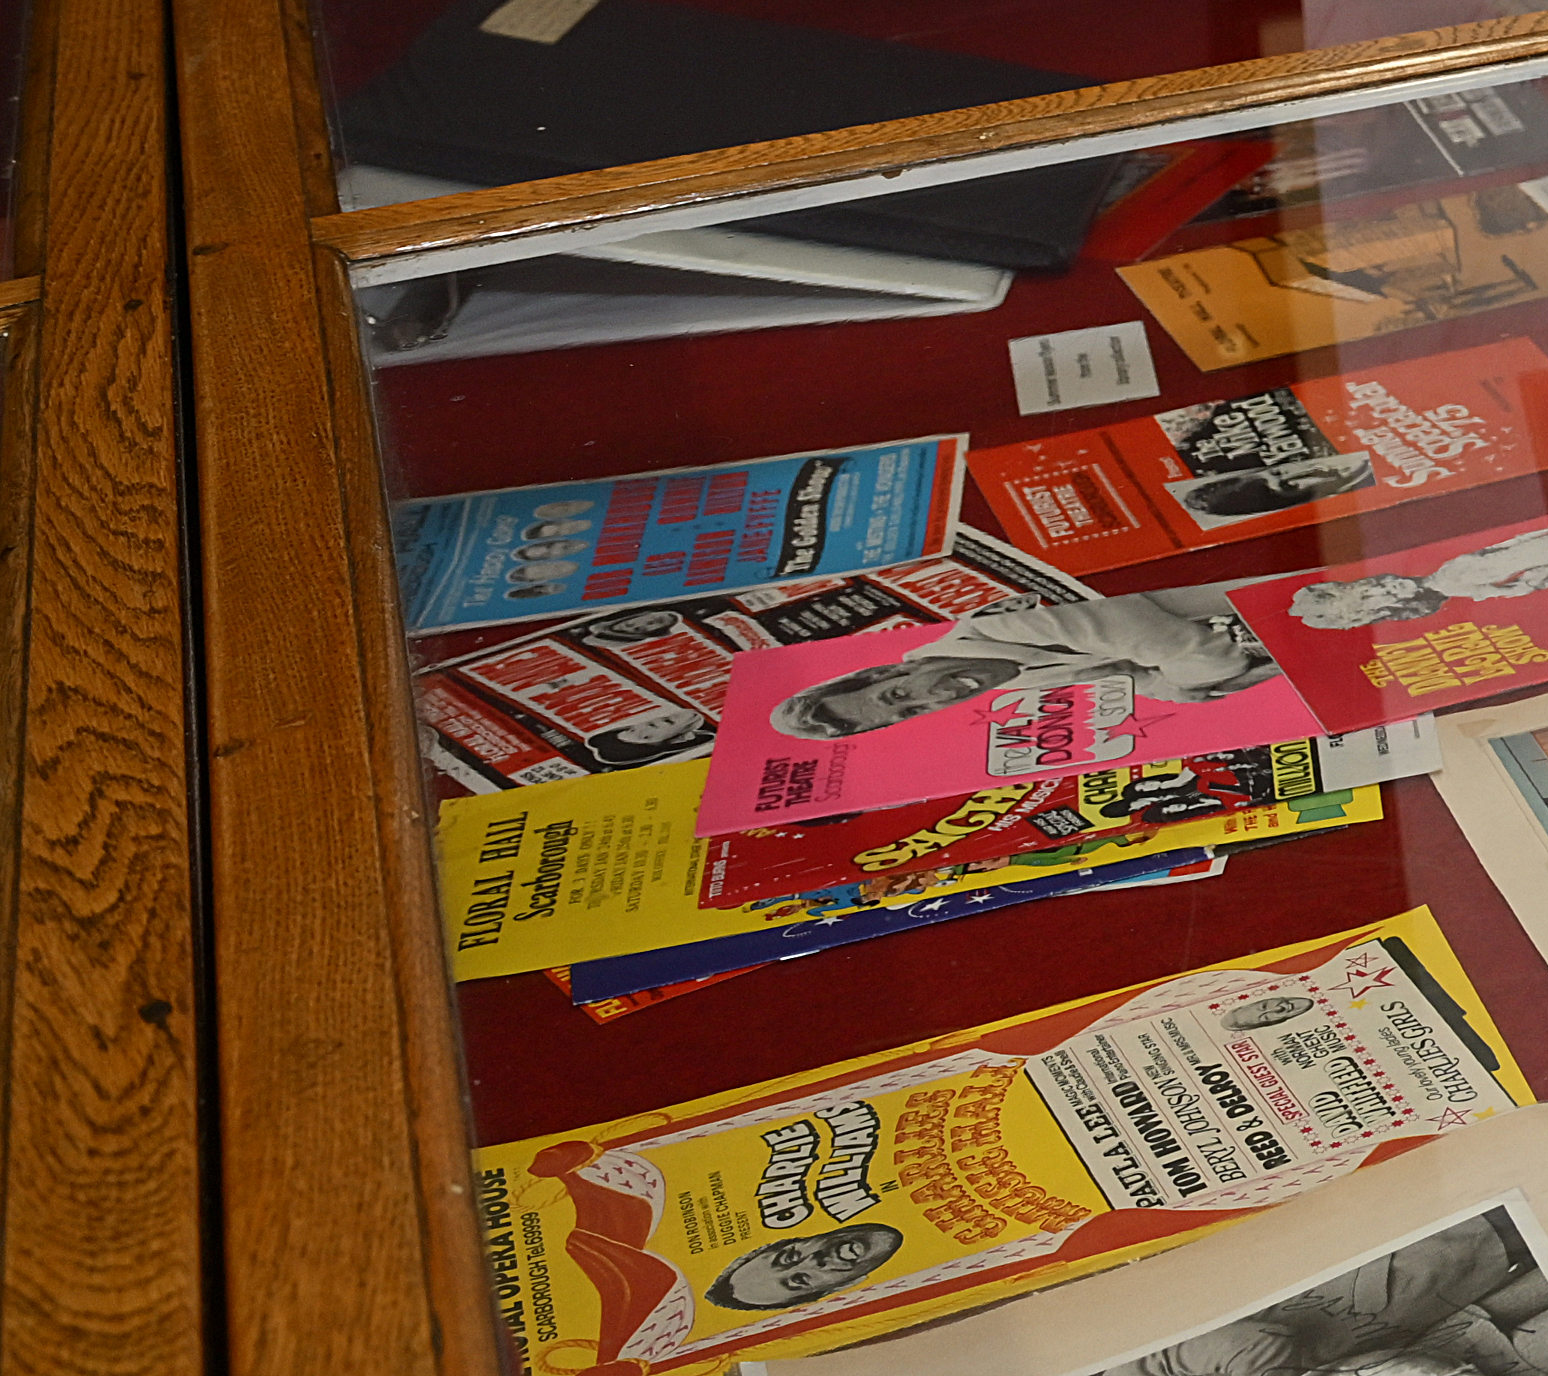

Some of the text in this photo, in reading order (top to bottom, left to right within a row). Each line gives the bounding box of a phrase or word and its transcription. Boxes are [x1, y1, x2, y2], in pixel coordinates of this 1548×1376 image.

[1242, 392, 1308, 466] Yarwood
[1353, 426, 1454, 488] Summer
[1372, 638, 1462, 697] DANNY
[995, 719, 1033, 748] VAL
[1036, 685, 1074, 765] DOONICAN
[755, 756, 790, 812] FUTURIST
[785, 758, 819, 808] THEATRE
[458, 810, 529, 953] FLORAL HALL
[513, 819, 578, 922] Scarborough
[1277, 1032, 1316, 1070] NORMAN
[1298, 1032, 1329, 1059] GHENT
[1314, 1025, 1347, 1052] MUSIC
[1381, 1001, 1478, 1103] CHARLIES GIRLS
[1196, 1063, 1292, 1170] REED & DELROY
[1231, 1040, 1303, 1121] SPECIAL GUEST STAR
[1308, 1090, 1364, 1139] DAVID
[812, 1100, 881, 1223] WILLIAMS
[894, 1087, 1007, 1245] CHARLIES
[1075, 1101, 1167, 1209] PAULA LEE
[1111, 1081, 1208, 1197] TOM HOWARD
[1157, 1077, 1248, 1183] BERYL JOHNSON
[708, 1171, 736, 1245] DUGGIE CHAPMAN
[756, 1118, 821, 1229] CHARLIE
[881, 1179, 899, 1194] IN
[956, 1145, 1093, 1234] MUSIC
[678, 1191, 704, 1254] DON ROBINSON
[528, 1260, 558, 1342] SCARBOROUGH
